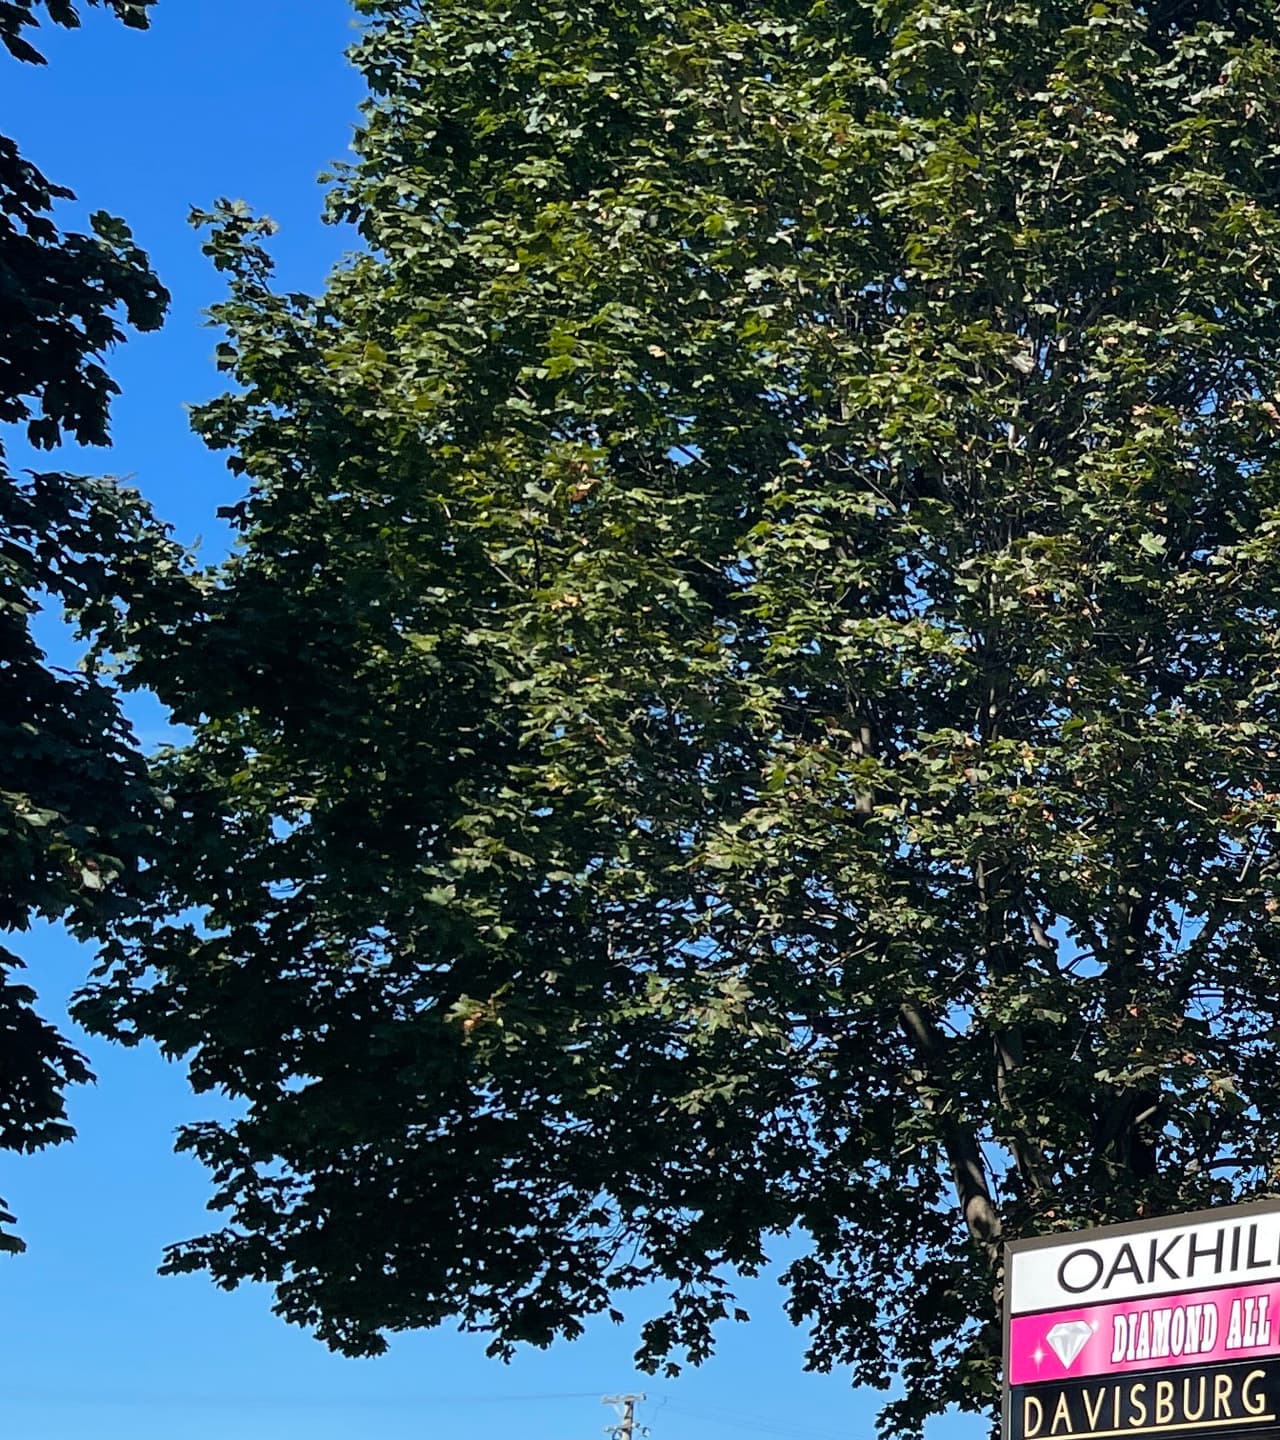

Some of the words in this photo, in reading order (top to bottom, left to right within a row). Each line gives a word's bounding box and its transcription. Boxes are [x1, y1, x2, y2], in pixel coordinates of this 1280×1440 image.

[1111, 1303, 1218, 1363] DIAMOND
[1225, 1295, 1272, 1350] ALL
[1024, 1370, 1267, 1438] DAVISBURG
